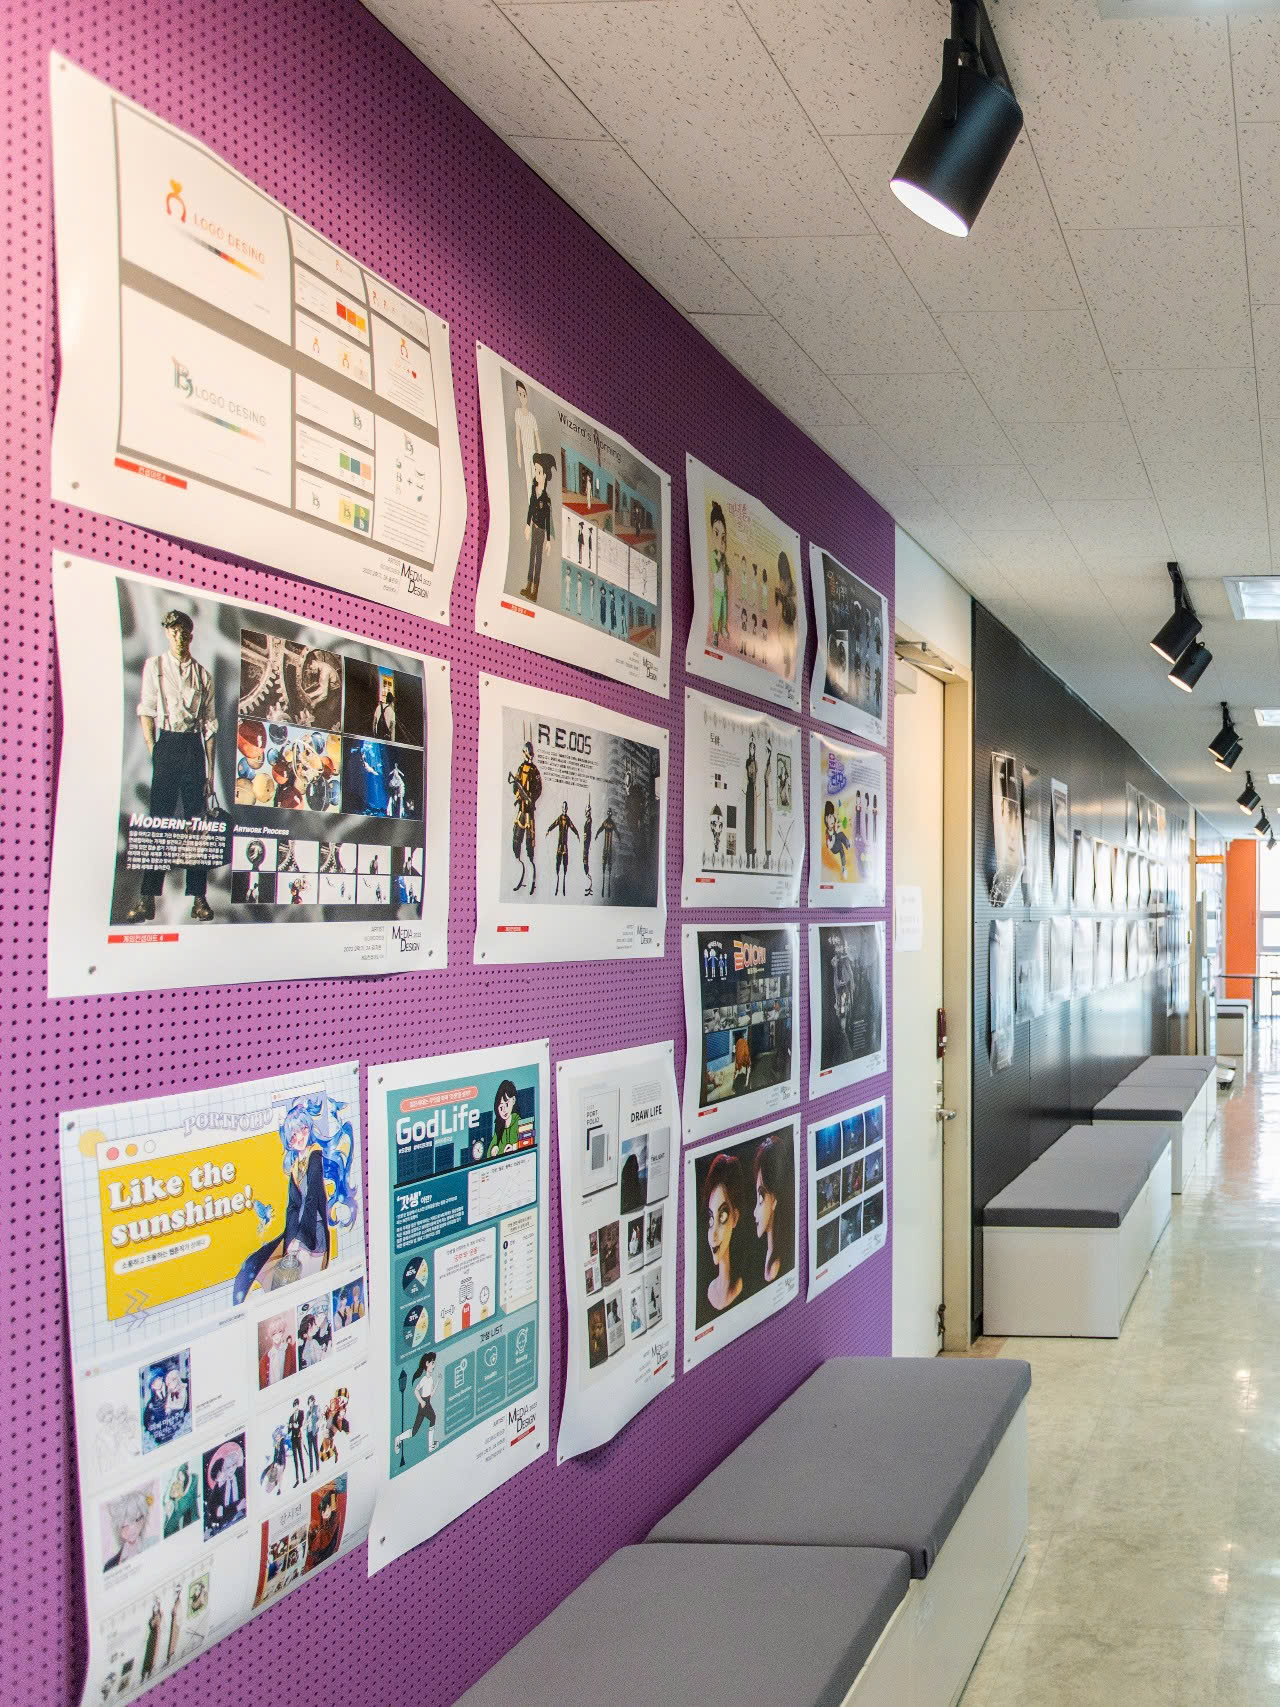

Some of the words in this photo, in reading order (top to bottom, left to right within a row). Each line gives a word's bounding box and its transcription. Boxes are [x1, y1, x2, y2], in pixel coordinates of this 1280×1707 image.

[195, 386, 224, 408] LOGO
[401, 563, 423, 583] MEDIA
[408, 580, 429, 599] DESIGN
[129, 814, 227, 834] MODERN-TIMES
[392, 926, 412, 940] MEDIA
[400, 939, 420, 952] DESIGN
[631, 1109, 650, 1123] DRAW
[650, 1104, 663, 1118] LIFE
[107, 1173, 184, 1212] Like
[189, 1161, 237, 1192] the
[111, 1185, 255, 1249] sunshine!
[508, 1406, 529, 1426] MEDIA
[516, 1413, 537, 1433] DESIGN
